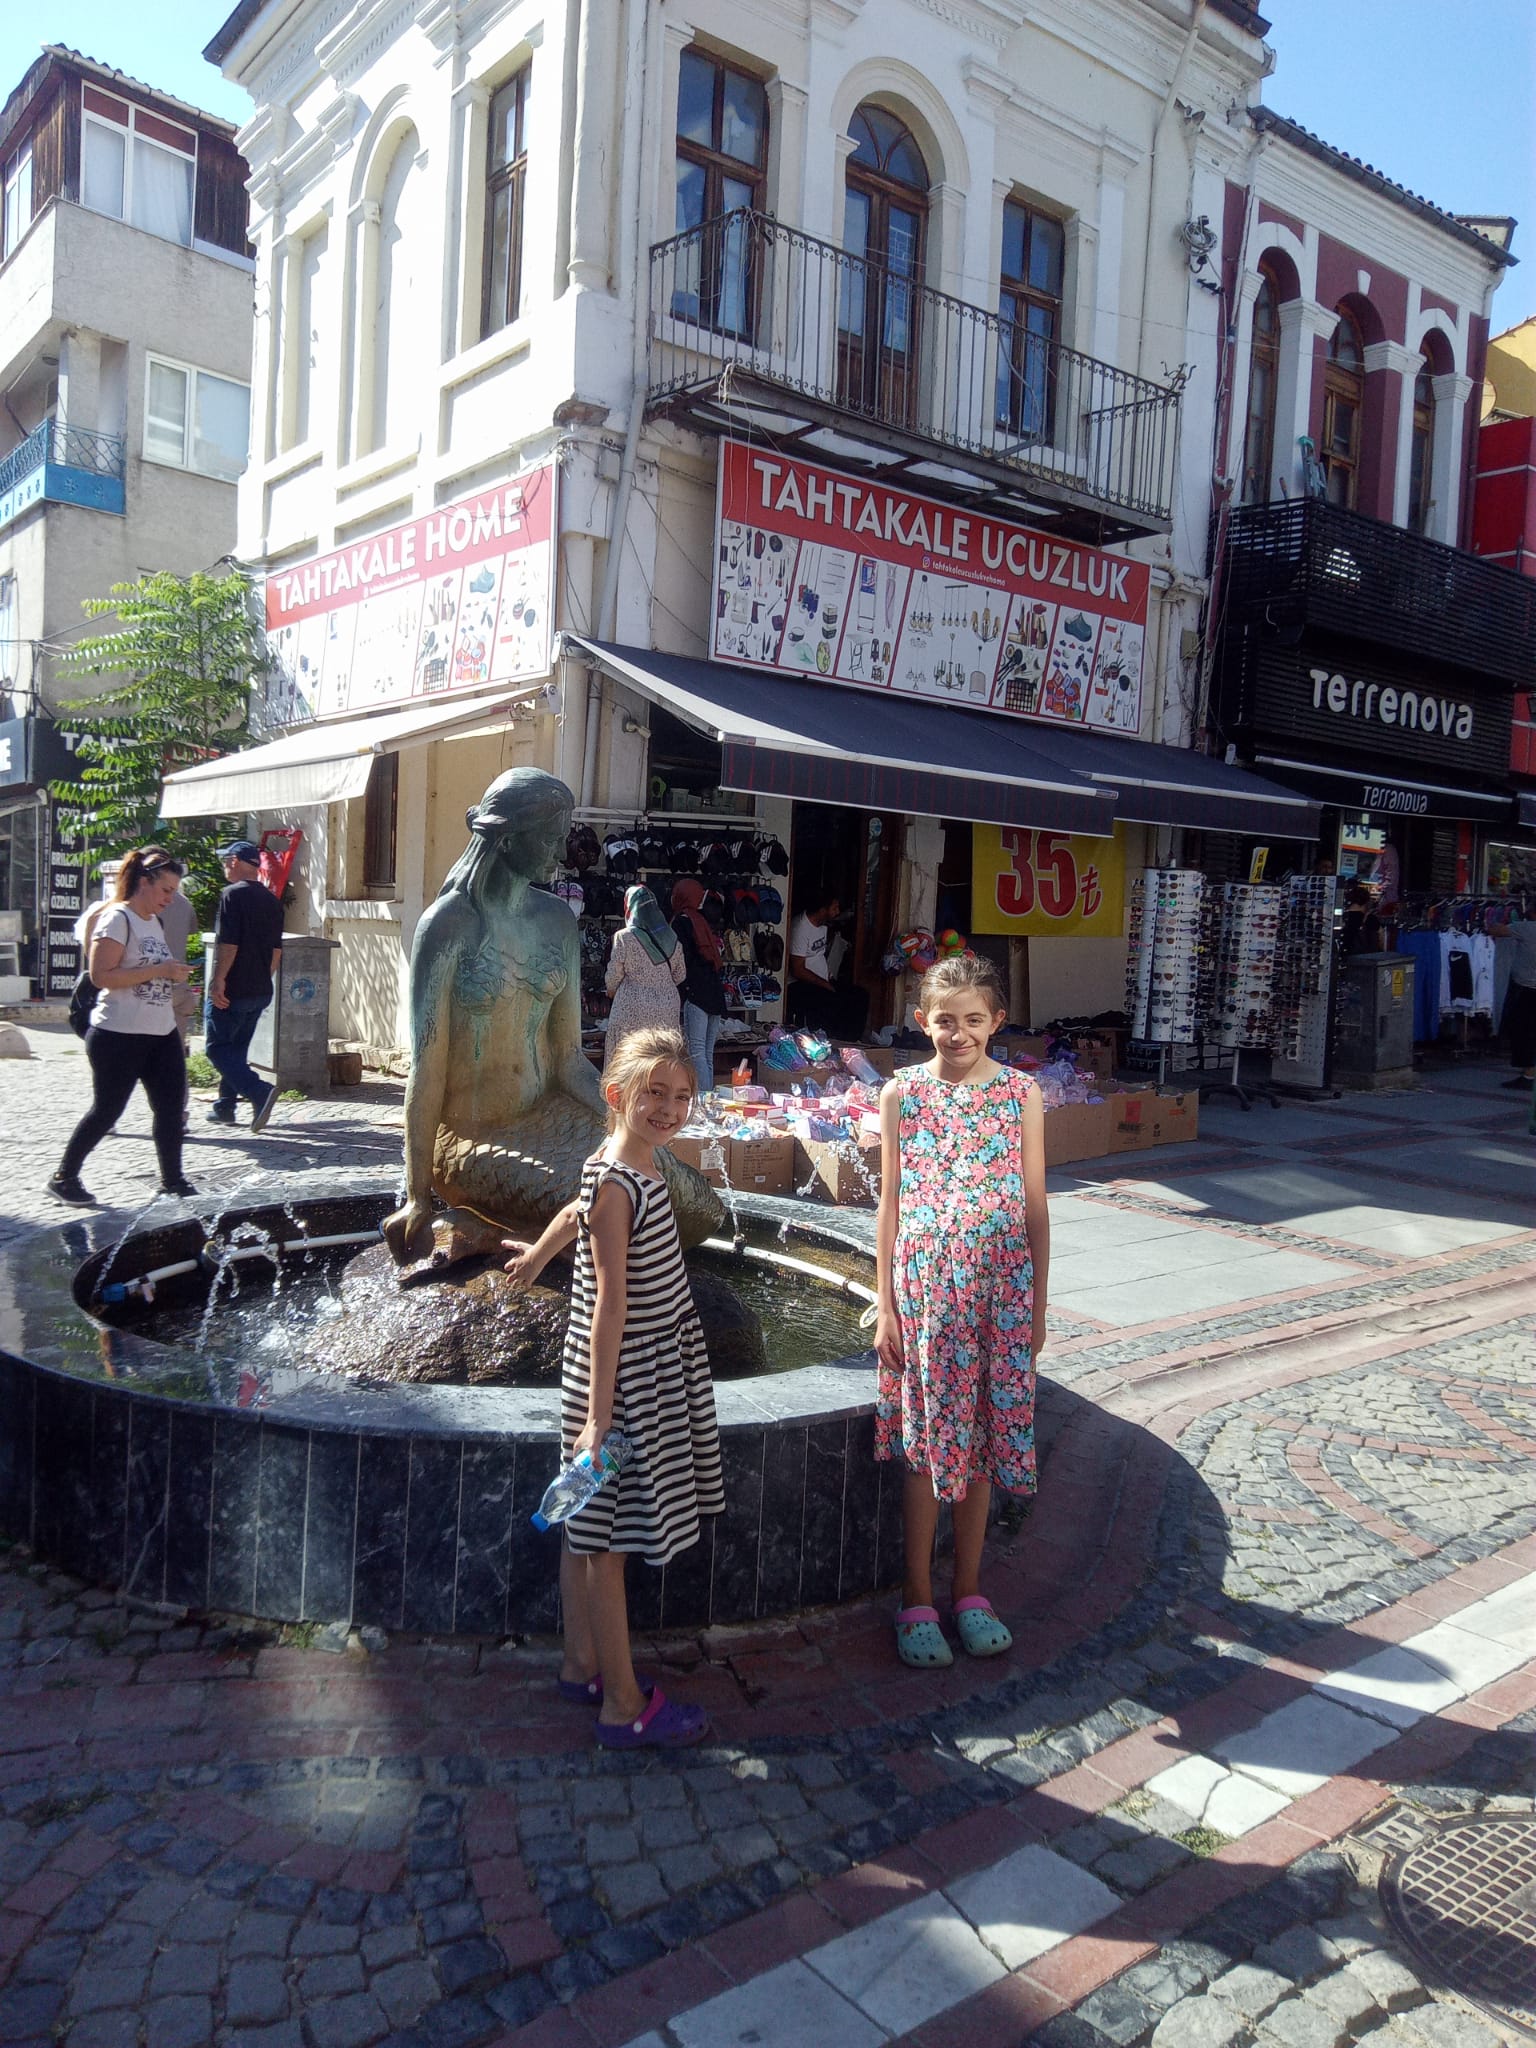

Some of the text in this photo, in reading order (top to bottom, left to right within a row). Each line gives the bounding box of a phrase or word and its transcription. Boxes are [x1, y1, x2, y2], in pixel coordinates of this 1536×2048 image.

[275, 485, 524, 613] TAHTAKALE HOME
[753, 456, 1131, 603] TAHTAKALE UCUZLUK
[1309, 668, 1473, 740] Terrenova
[50, 891, 81, 911] ÖZDİLEK
[54, 873, 79, 889] SOLEY
[52, 953, 76, 968] HAVLU
